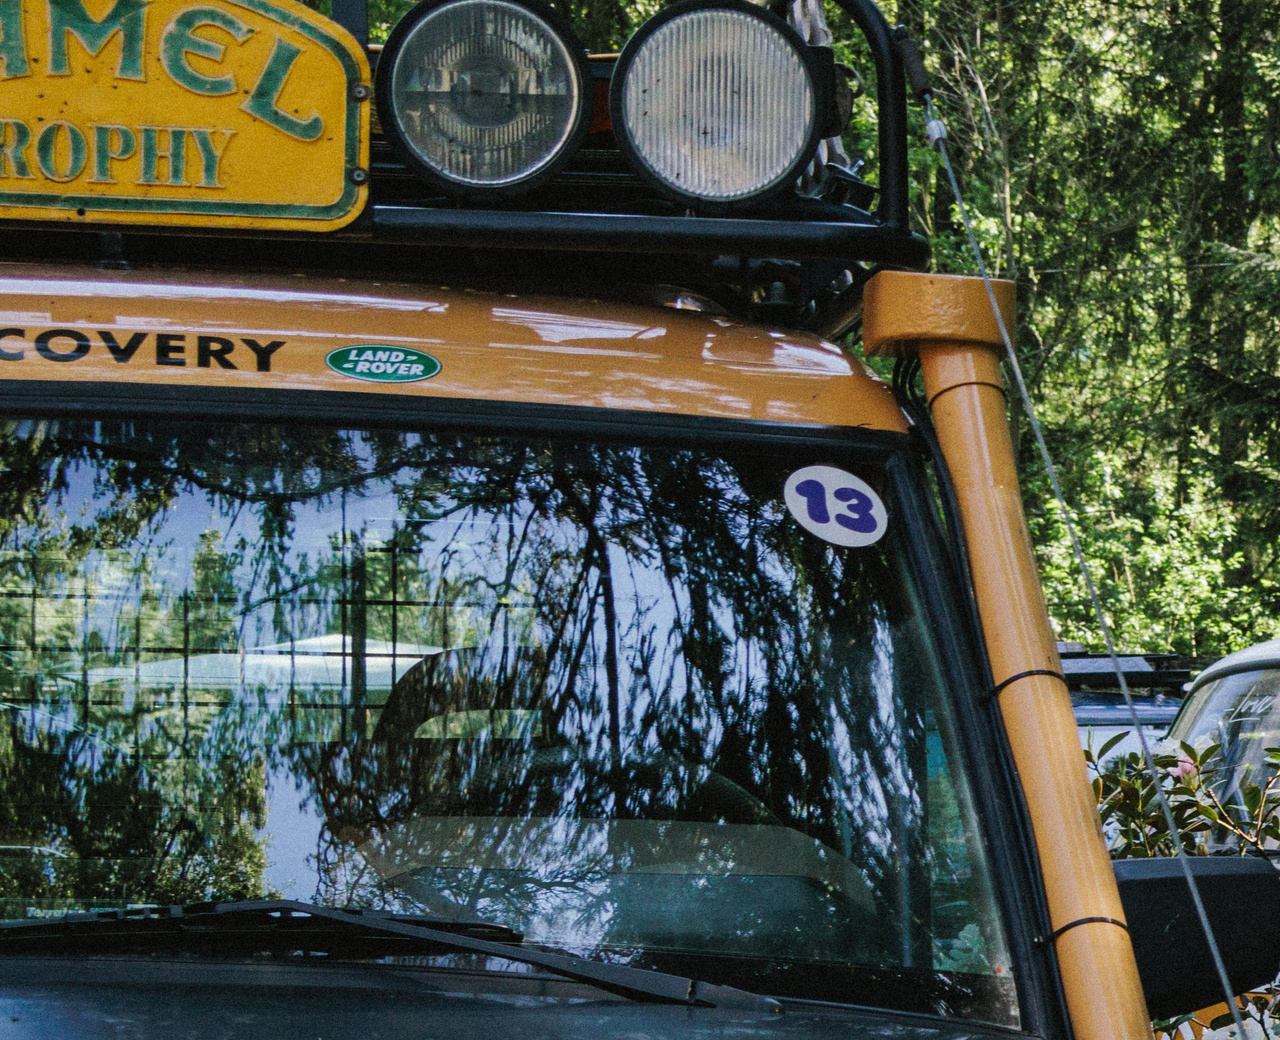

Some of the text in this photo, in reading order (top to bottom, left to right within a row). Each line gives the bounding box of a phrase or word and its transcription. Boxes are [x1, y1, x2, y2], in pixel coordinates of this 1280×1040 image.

[0, 117, 238, 189] ROPHY
[0, 327, 287, 373] COVERY
[355, 361, 425, 376] ROVER
[795, 479, 878, 534] 13
